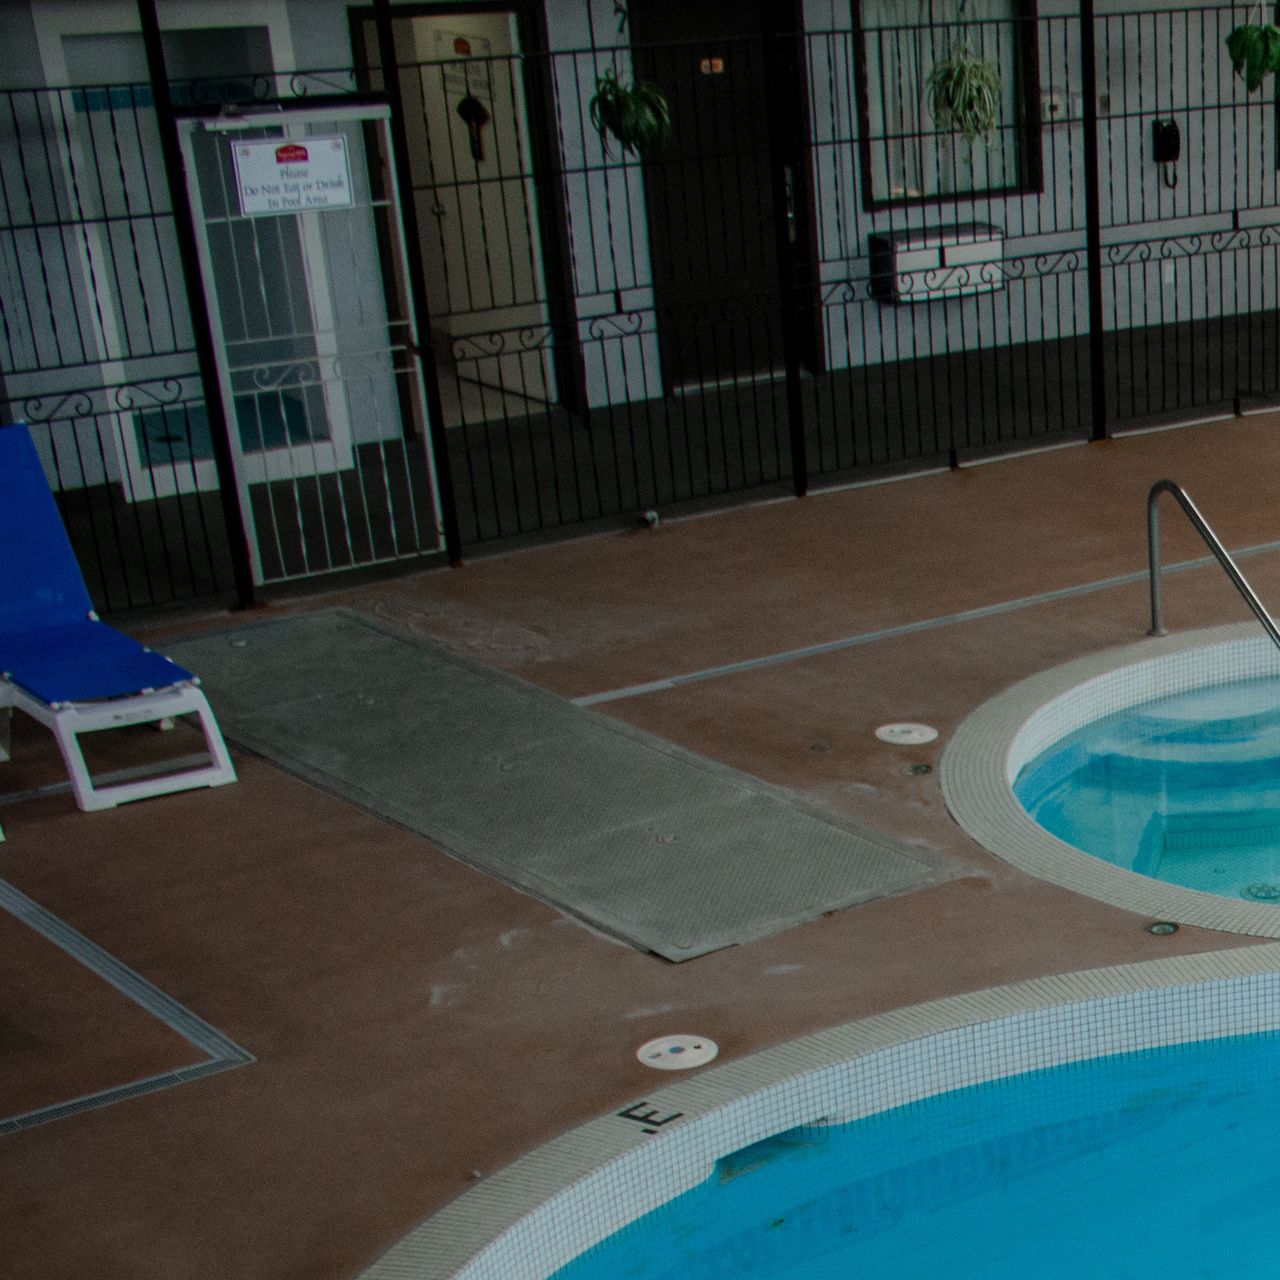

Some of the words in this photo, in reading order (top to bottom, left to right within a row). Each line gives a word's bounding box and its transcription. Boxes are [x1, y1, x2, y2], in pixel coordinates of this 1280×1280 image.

[280, 165, 310, 181] Please
[244, 186, 259, 197] Do
[261, 183, 280, 195] Not
[283, 181, 300, 194] Eat
[303, 182, 313, 192] or
[316, 175, 344, 191] Drink
